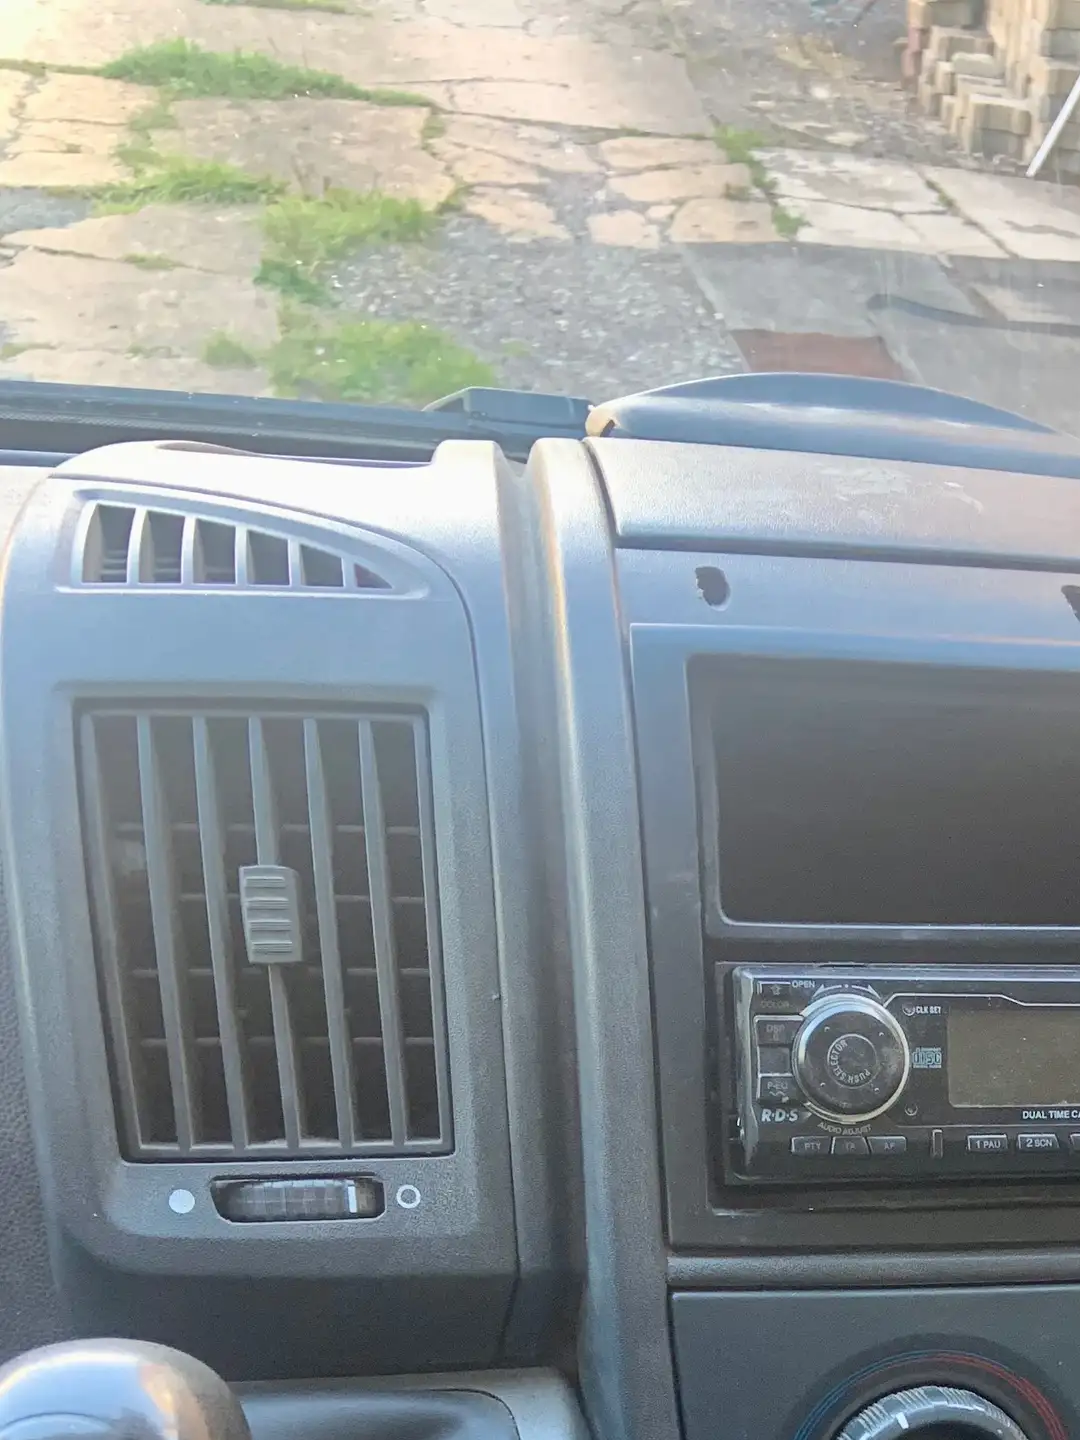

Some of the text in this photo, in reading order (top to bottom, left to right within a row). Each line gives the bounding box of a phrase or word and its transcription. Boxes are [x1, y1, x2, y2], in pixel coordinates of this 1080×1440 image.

[792, 980, 815, 988] OPEN
[1022, 1110, 1047, 1120] DUAL
[1048, 1110, 1070, 1119] TIME
[804, 1142, 821, 1151] PTY
[983, 1140, 1001, 1149] PAU
[1026, 1138, 1053, 1148] 2 SCN
